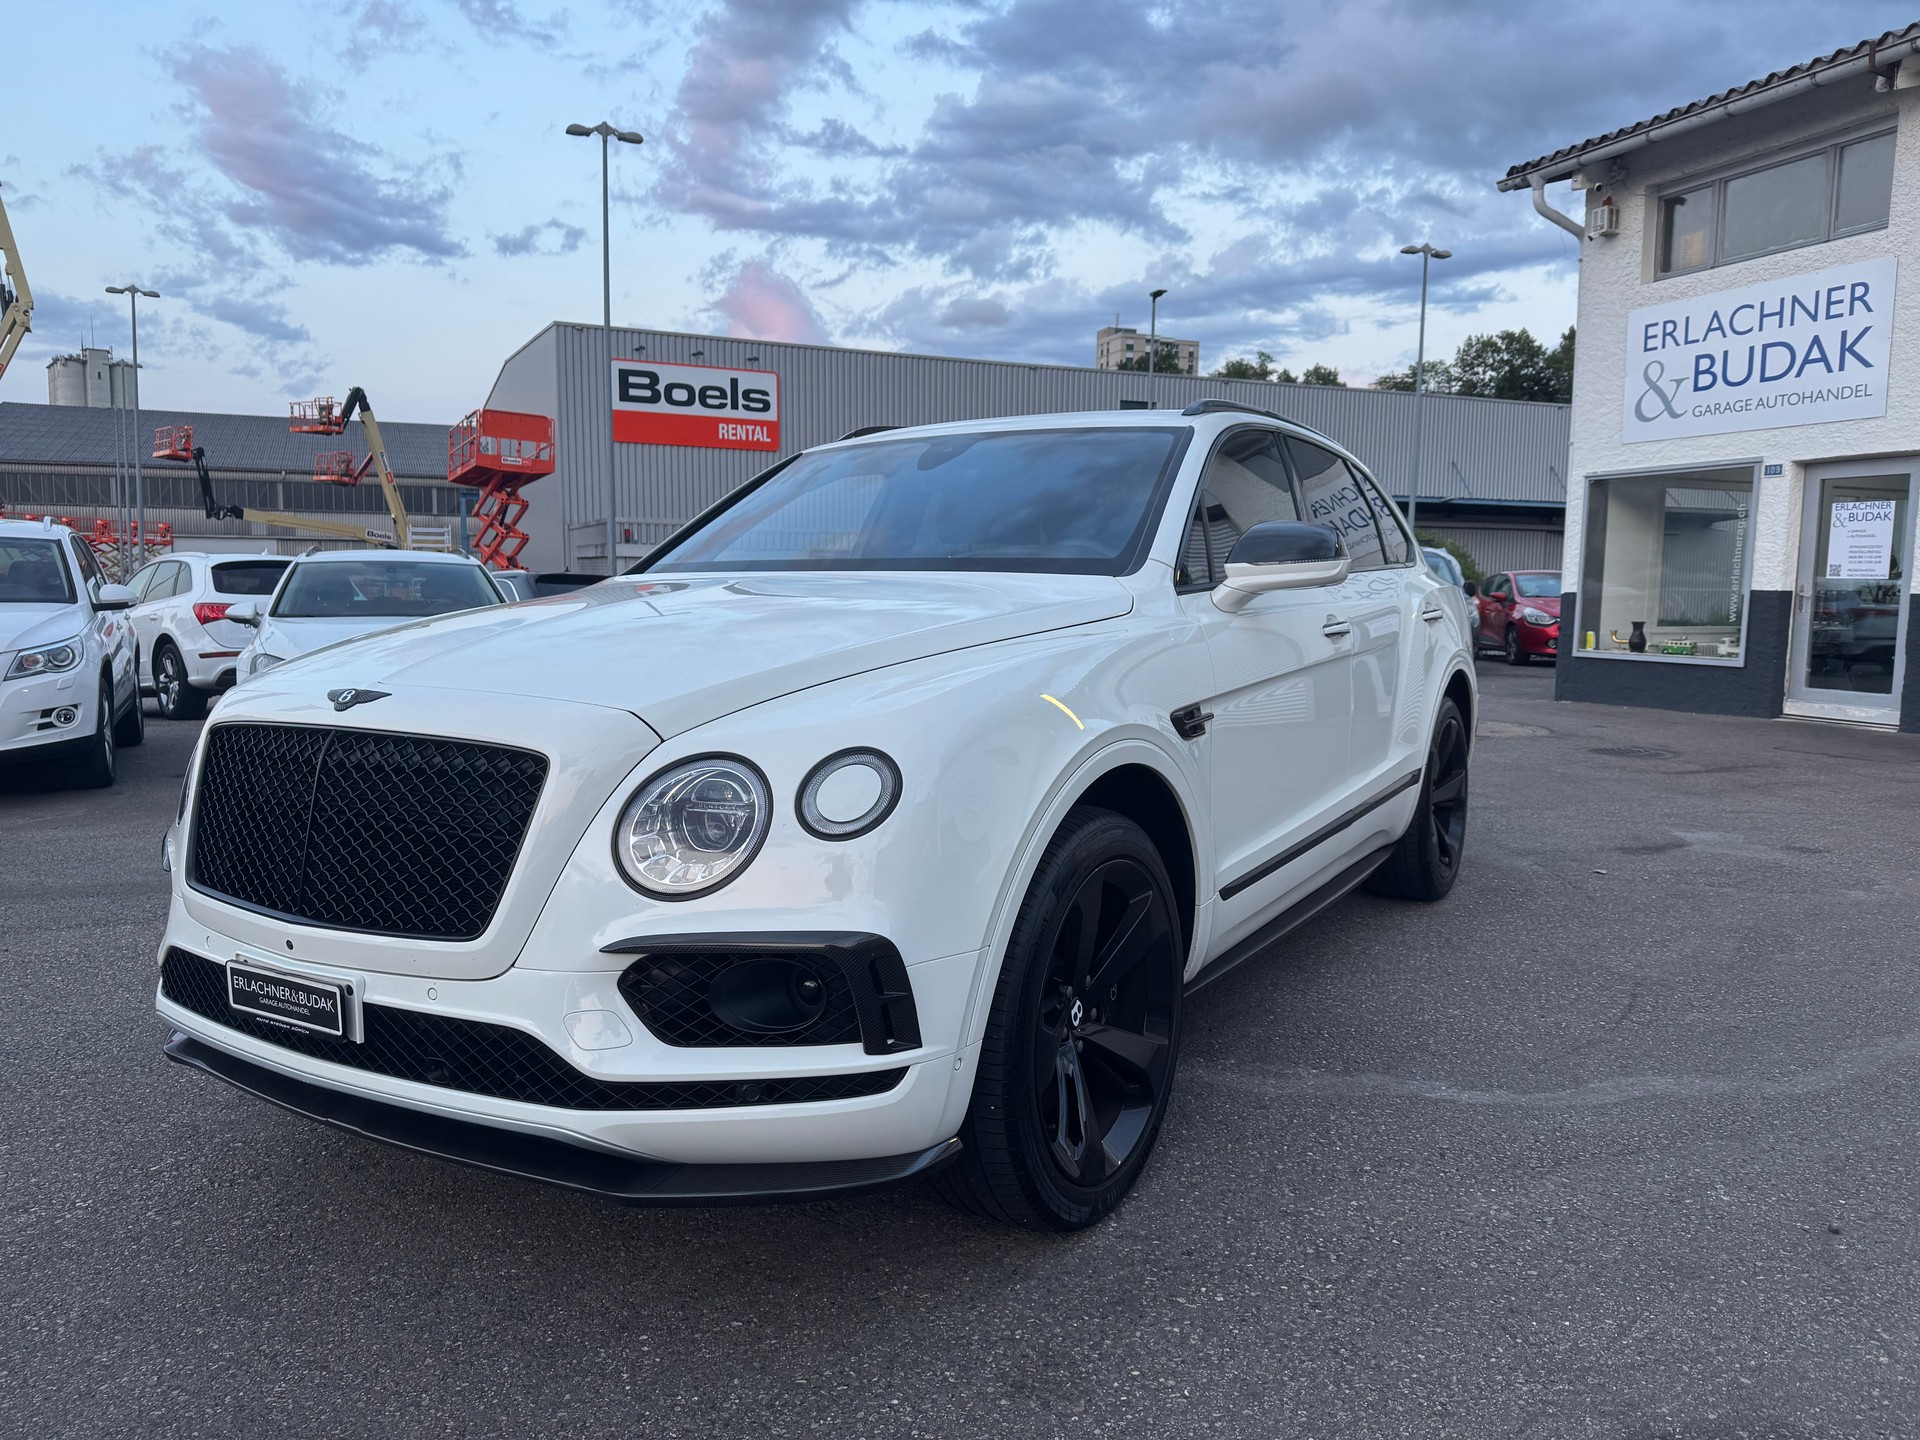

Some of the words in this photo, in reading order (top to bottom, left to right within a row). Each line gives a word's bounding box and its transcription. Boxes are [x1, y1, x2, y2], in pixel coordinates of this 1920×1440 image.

[1643, 281, 1874, 353] ERLACHNER
[1634, 360, 1690, 423] &
[1692, 325, 1875, 393] BUDAK
[618, 368, 771, 413] Boels
[1691, 398, 1753, 418] GARAGE
[1754, 383, 1873, 411] AUTOHANDEL
[718, 423, 771, 442] RENTAL
[1832, 512, 1848, 528] &
[1848, 511, 1892, 522] BUDAK
[1835, 501, 1892, 511] ERLACHNER
[367, 530, 392, 540] Boels
[1728, 503, 1747, 622] www.erlachnerag.ch
[259, 996, 278, 1008] GARAGE
[277, 1002, 311, 1016] AUTOHANDEL
